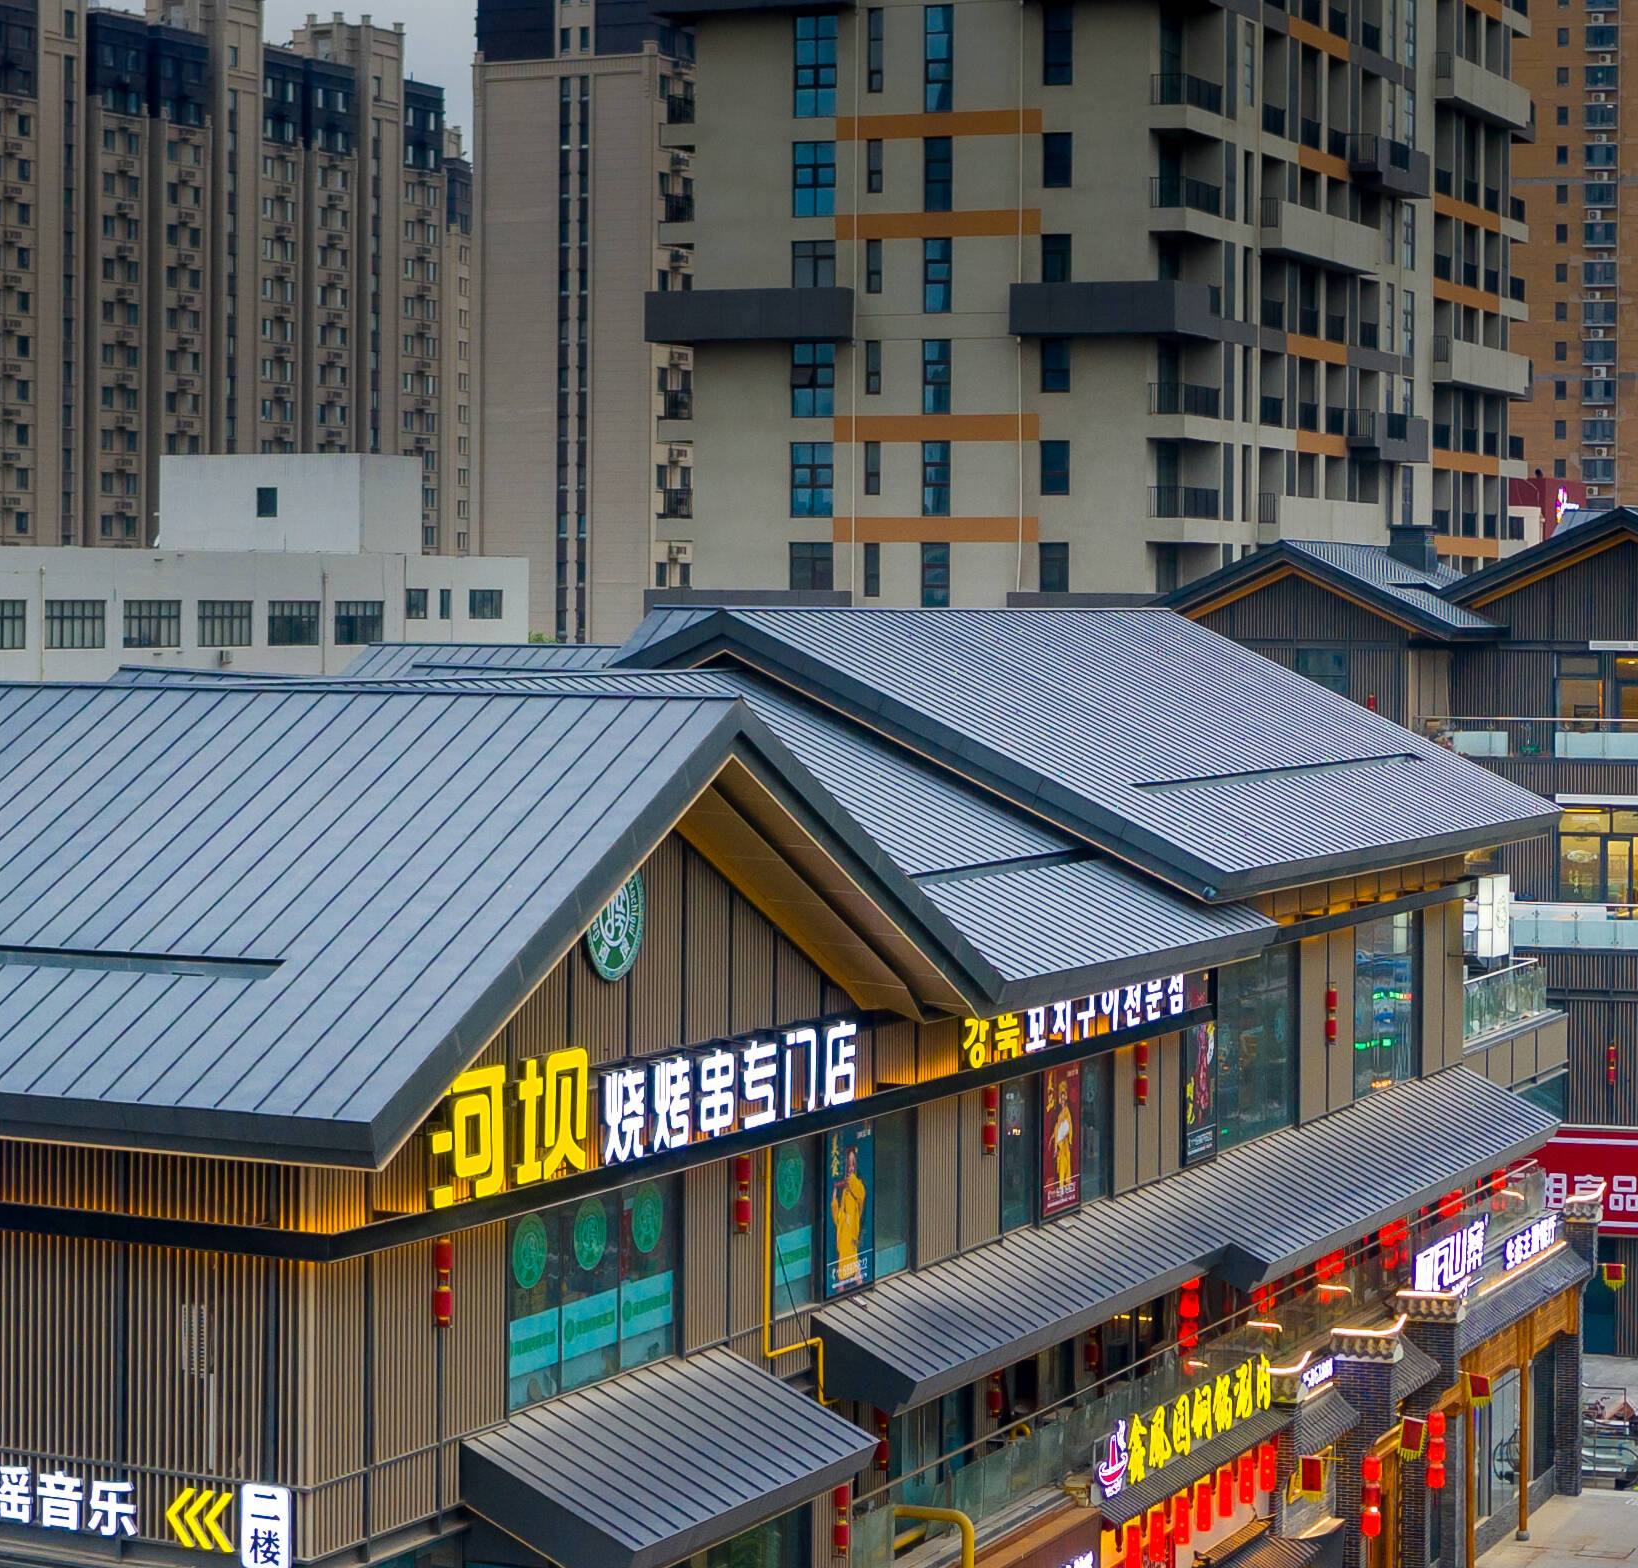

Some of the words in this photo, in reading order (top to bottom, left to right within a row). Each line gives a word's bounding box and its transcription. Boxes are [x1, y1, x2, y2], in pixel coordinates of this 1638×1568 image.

[428, 1047, 588, 1210] 河坝
[604, 1021, 857, 1165] 烧烤串专门店
[249, 1490, 282, 1567] 二楼
